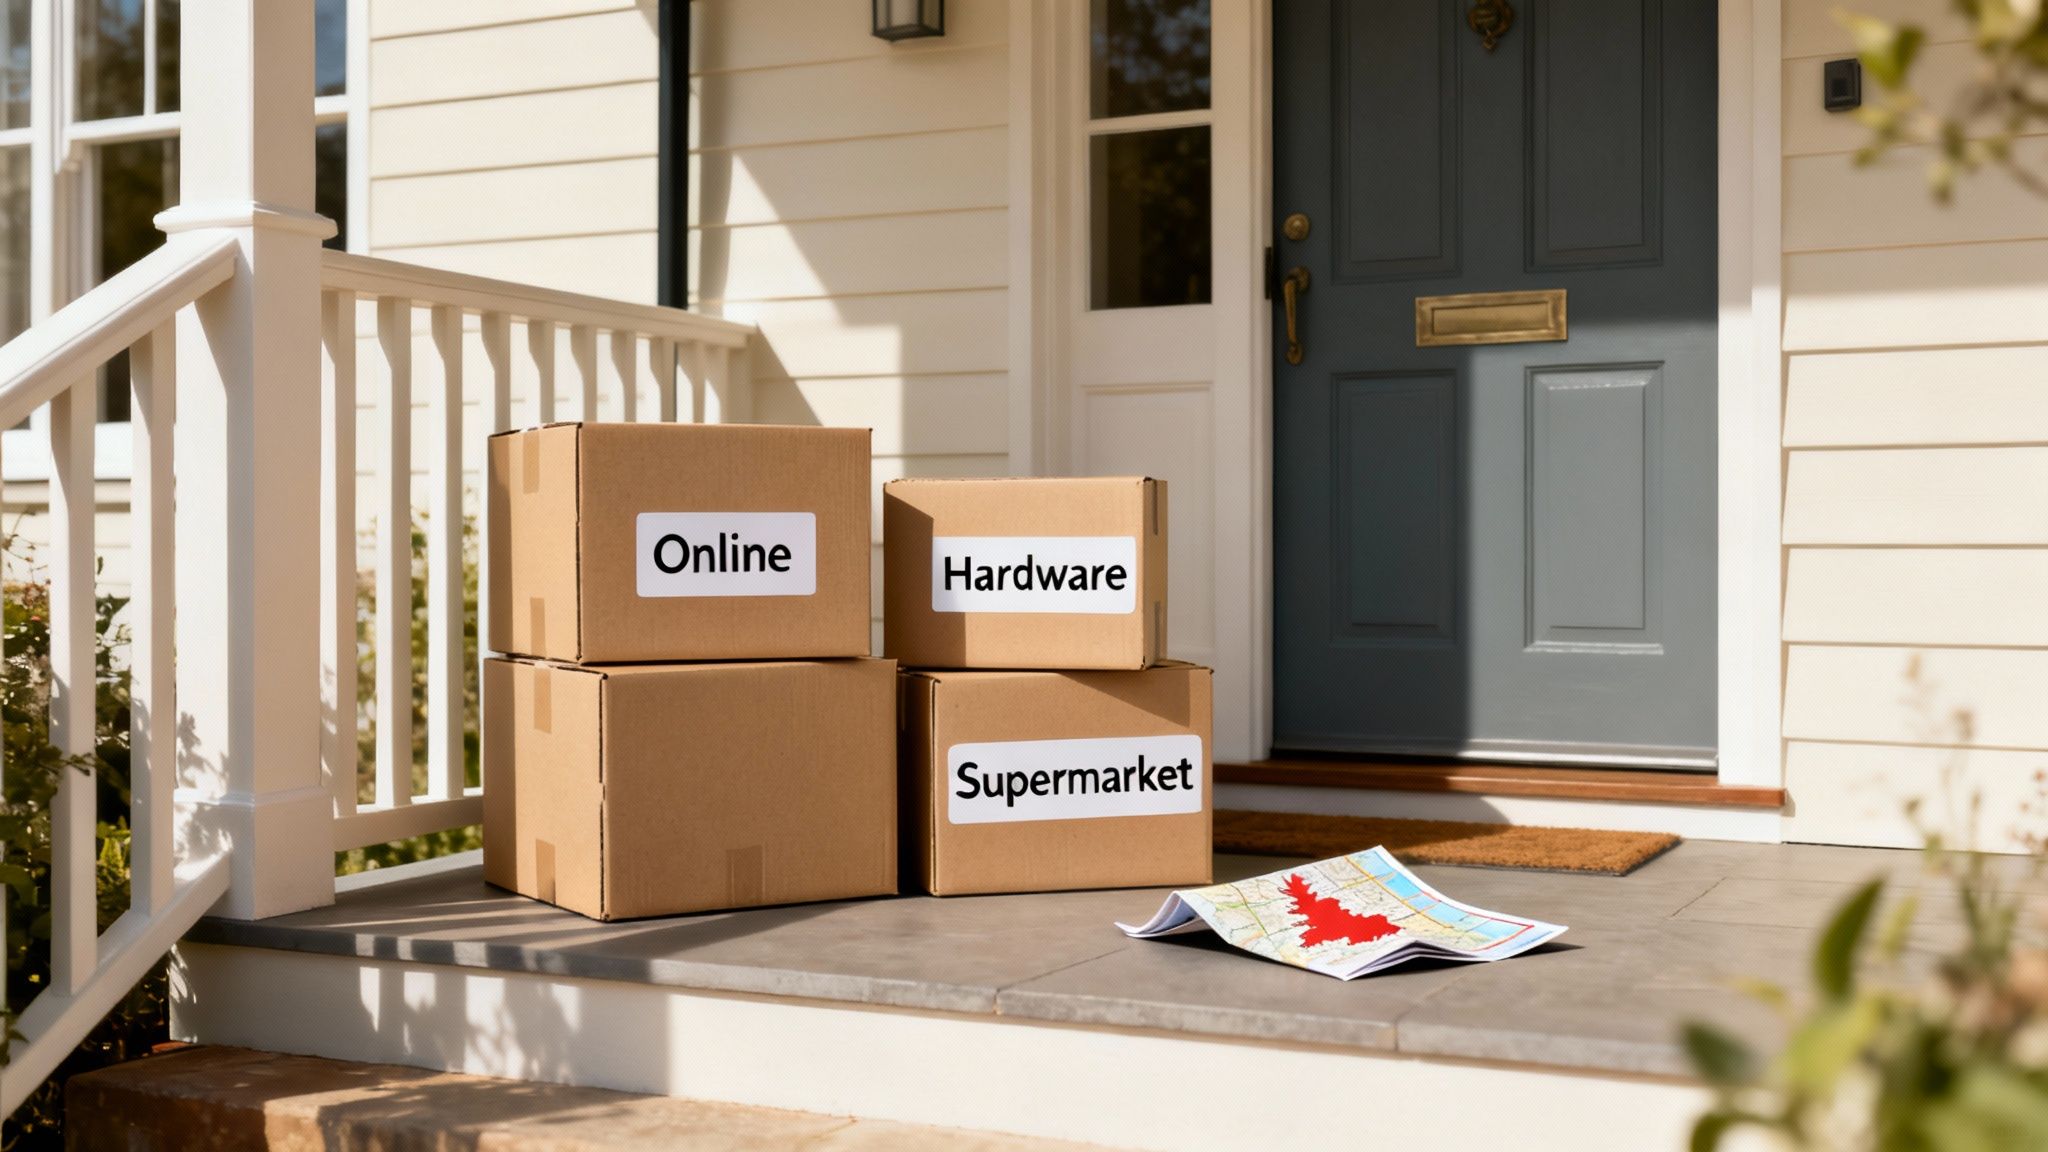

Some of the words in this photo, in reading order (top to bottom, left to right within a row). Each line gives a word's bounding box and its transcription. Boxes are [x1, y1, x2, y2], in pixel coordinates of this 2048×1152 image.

[653, 532, 792, 574] Online
[944, 554, 1127, 592] Hardware
[955, 754, 1194, 807] Supermarket
